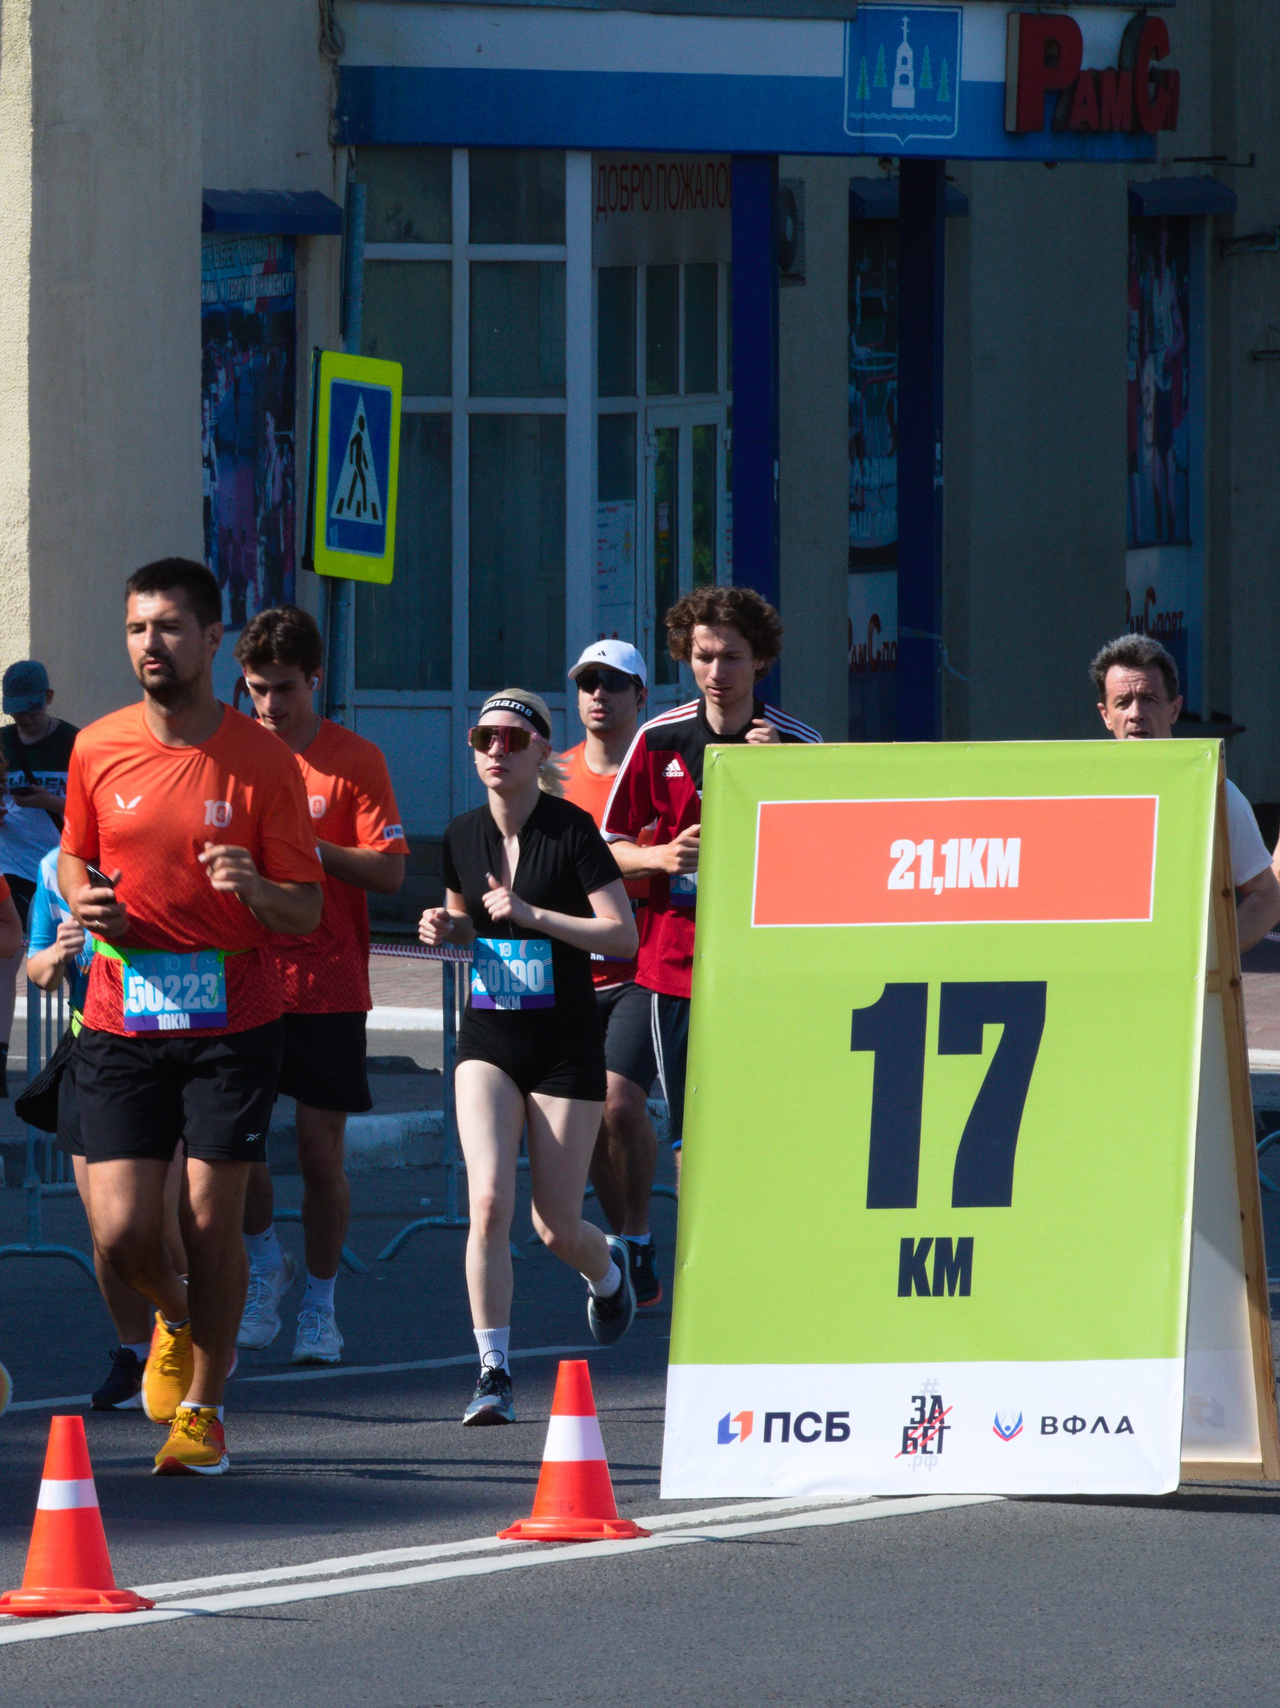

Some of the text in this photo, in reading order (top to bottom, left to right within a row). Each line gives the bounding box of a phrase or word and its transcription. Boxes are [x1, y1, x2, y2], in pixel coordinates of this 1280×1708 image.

[597, 162, 732, 222] ДОБРО ПОЖАЛО
[887, 838, 1021, 895] 21,1КМ
[127, 973, 219, 1013] 50223
[477, 959, 546, 993] 50190
[850, 981, 1047, 1209] 17
[897, 1237, 974, 1297] КМ
[763, 1411, 851, 1443] ПСБ
[910, 1395, 945, 1425] ЗА
[1040, 1415, 1135, 1435] ВФЛА
